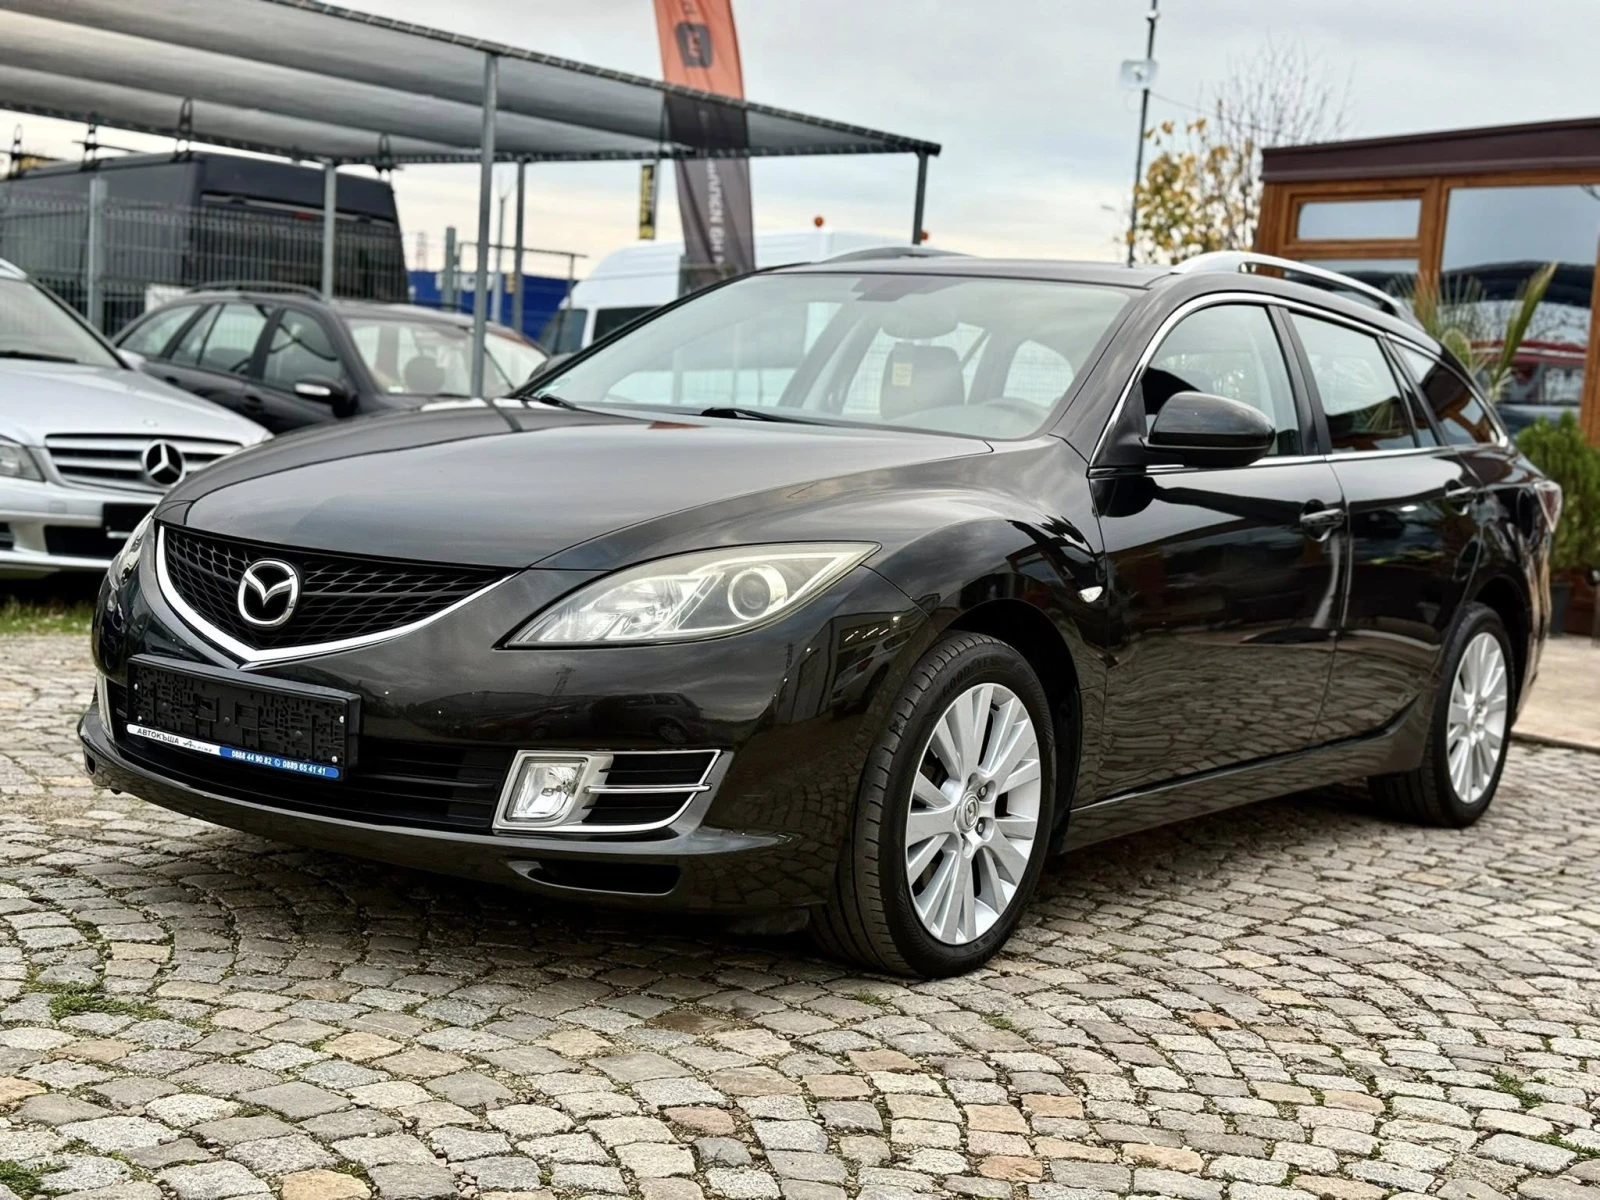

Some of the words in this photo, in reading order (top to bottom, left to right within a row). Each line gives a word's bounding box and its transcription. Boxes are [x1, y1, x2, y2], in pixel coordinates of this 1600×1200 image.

[231, 750, 246, 759] 0888
[246, 753, 255, 762] 44
[308, 765, 316, 774] 41
[317, 767, 326, 776] 41
